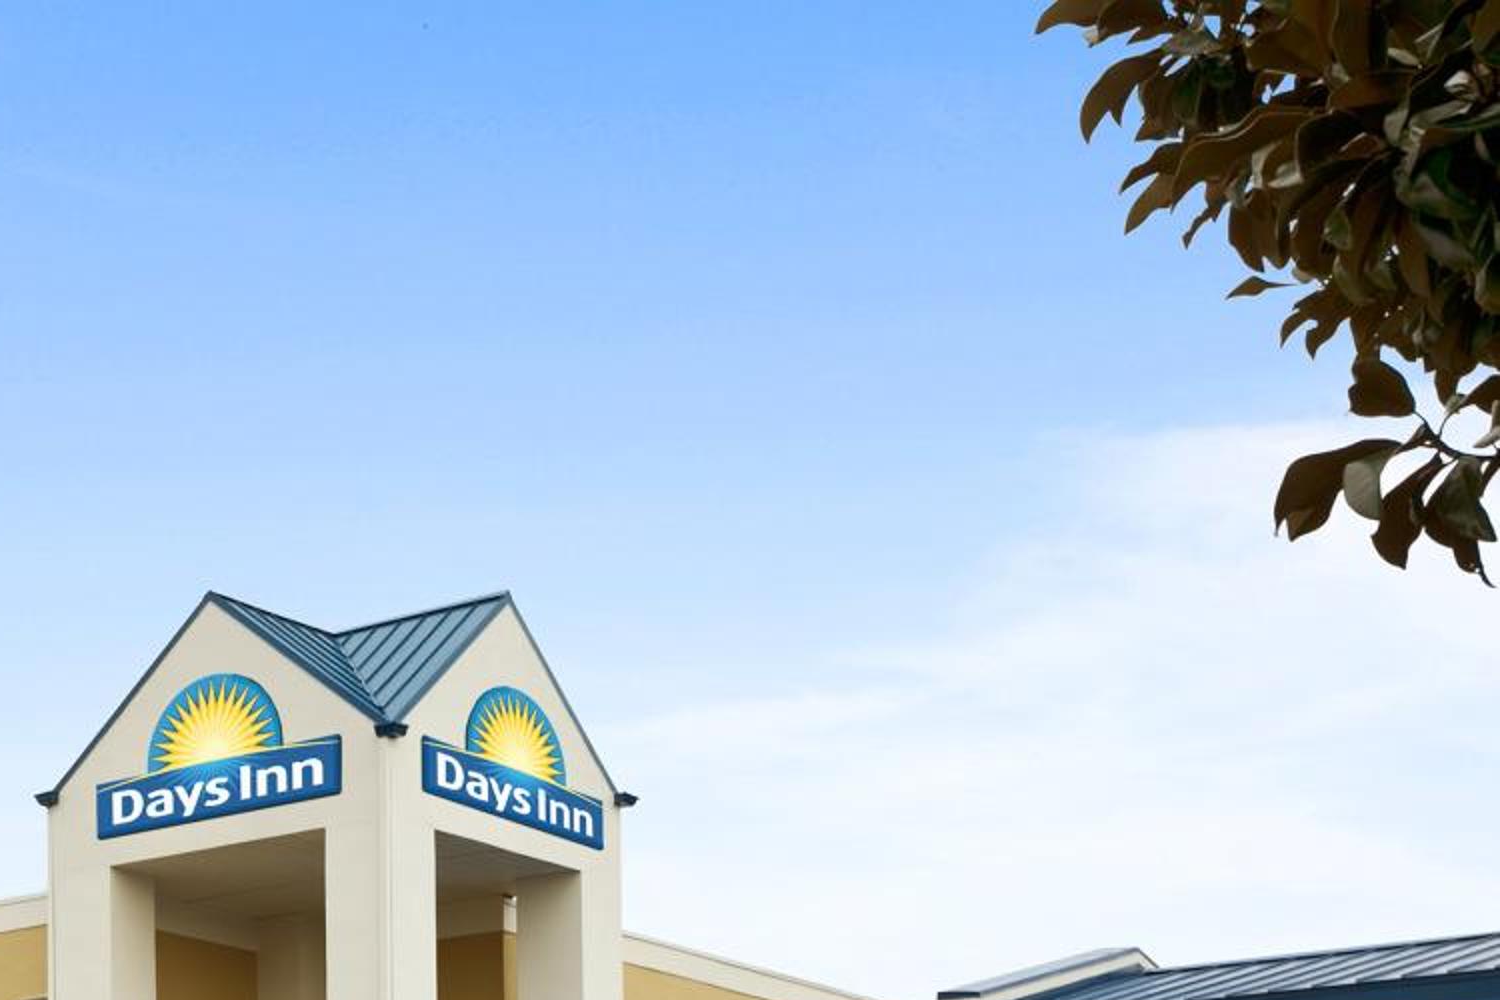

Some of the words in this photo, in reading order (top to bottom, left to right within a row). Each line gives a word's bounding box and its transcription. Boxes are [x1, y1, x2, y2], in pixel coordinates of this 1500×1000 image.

[111, 776, 231, 826] Days
[239, 757, 324, 801] Inn
[436, 751, 531, 815] Days
[537, 788, 594, 837] Inn
